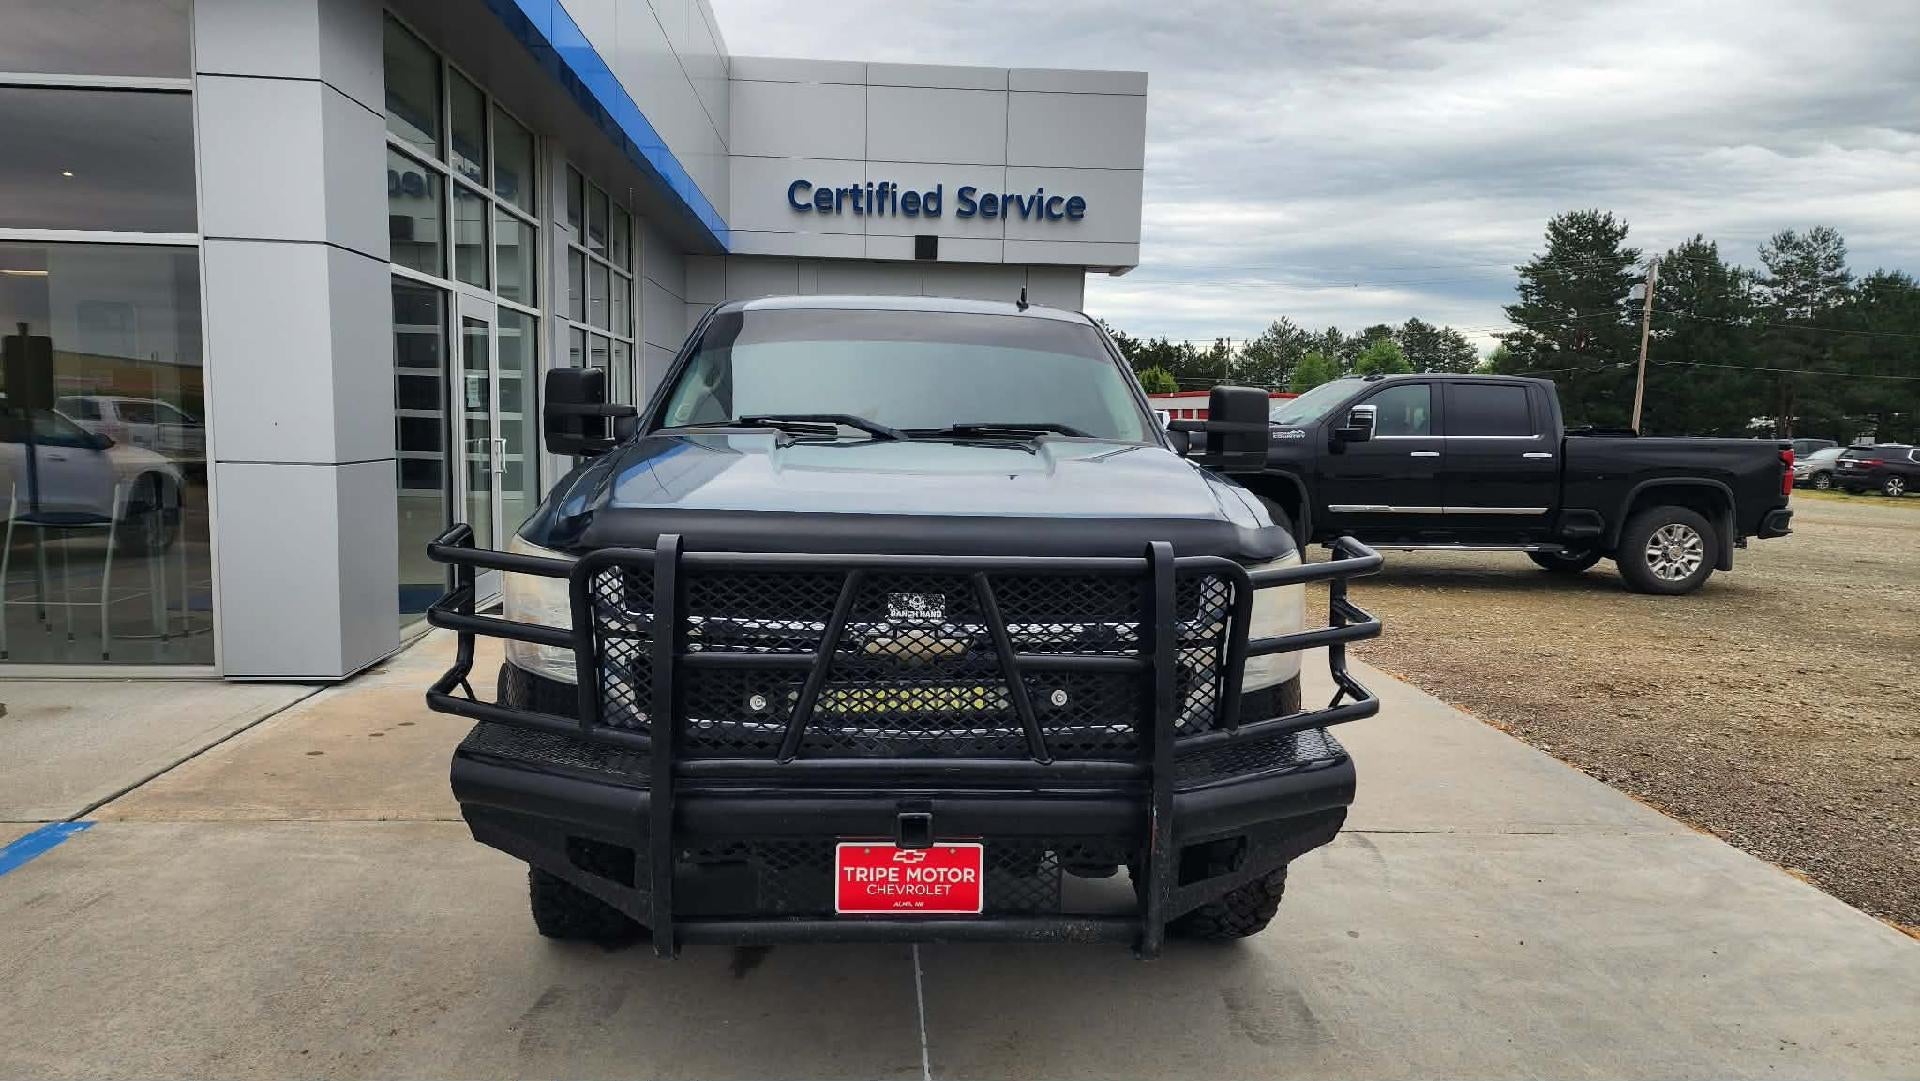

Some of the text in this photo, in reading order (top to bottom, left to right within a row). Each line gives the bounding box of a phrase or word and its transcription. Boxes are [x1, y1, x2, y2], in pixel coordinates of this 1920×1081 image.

[787, 179, 1087, 220] Certified Service
[843, 867, 976, 883] TRIPE MOTOR
[866, 884, 953, 895] CHEVROLET
